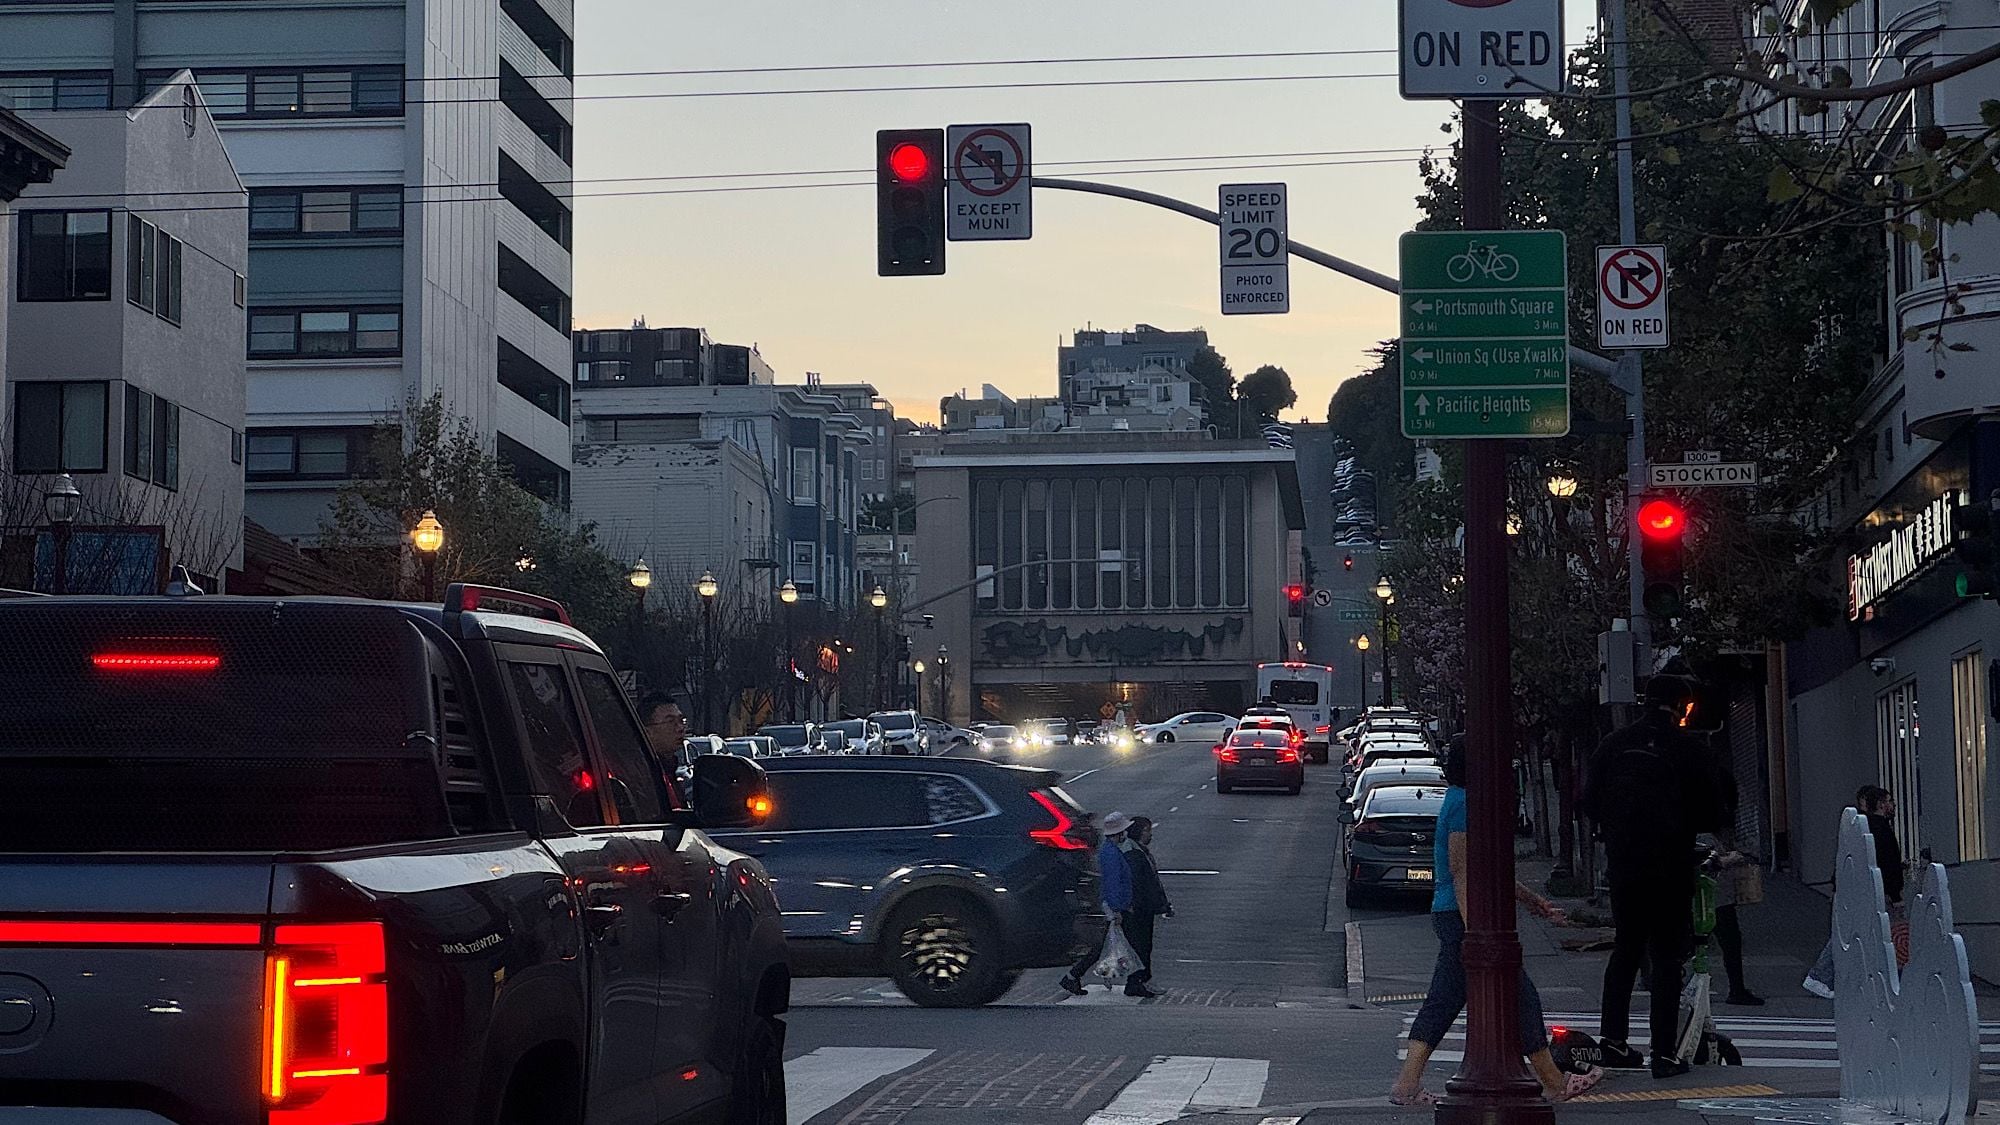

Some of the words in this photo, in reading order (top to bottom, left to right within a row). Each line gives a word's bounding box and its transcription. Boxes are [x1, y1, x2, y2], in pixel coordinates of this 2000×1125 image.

[1413, 31, 1461, 67] ON
[1480, 31, 1551, 66] RED
[1225, 192, 1281, 207] SPEED
[957, 203, 1021, 216] EXCEPT
[1231, 210, 1275, 224] LIMIT
[968, 219, 1010, 231] MUNI
[1228, 228, 1280, 259] 20
[1236, 274, 1273, 286] PHOTO
[1225, 291, 1285, 304] ENFORCED
[1436, 299, 1506, 315] Portsmouth
[1510, 298, 1554, 317] Square
[1410, 322, 1424, 331] 0.4
[1426, 322, 1437, 331] Mi
[1534, 320, 1540, 330] 3
[1543, 320, 1559, 329] Min
[1604, 319, 1625, 335] ON
[1632, 318, 1663, 334] RED
[1436, 349, 1471, 364] Union
[1475, 348, 1488, 366] Sq
[1493, 348, 1520, 364] (Use
[1523, 347, 1564, 363] Xwalk)
[1410, 370, 1424, 380] 0.9
[1427, 370, 1437, 379] Mi
[1535, 369, 1541, 378] 7
[1544, 369, 1560, 378] Min
[1437, 396, 1479, 413] Pacific
[1483, 396, 1531, 416] Heights
[1425, 419, 1435, 429] Mi
[1531, 417, 1543, 427] 15
[1544, 417, 1561, 427] Min
[1687, 453, 1708, 461] 1300
[1656, 467, 1752, 482] STOCKTON
[1892, 523, 1917, 583] BANK
